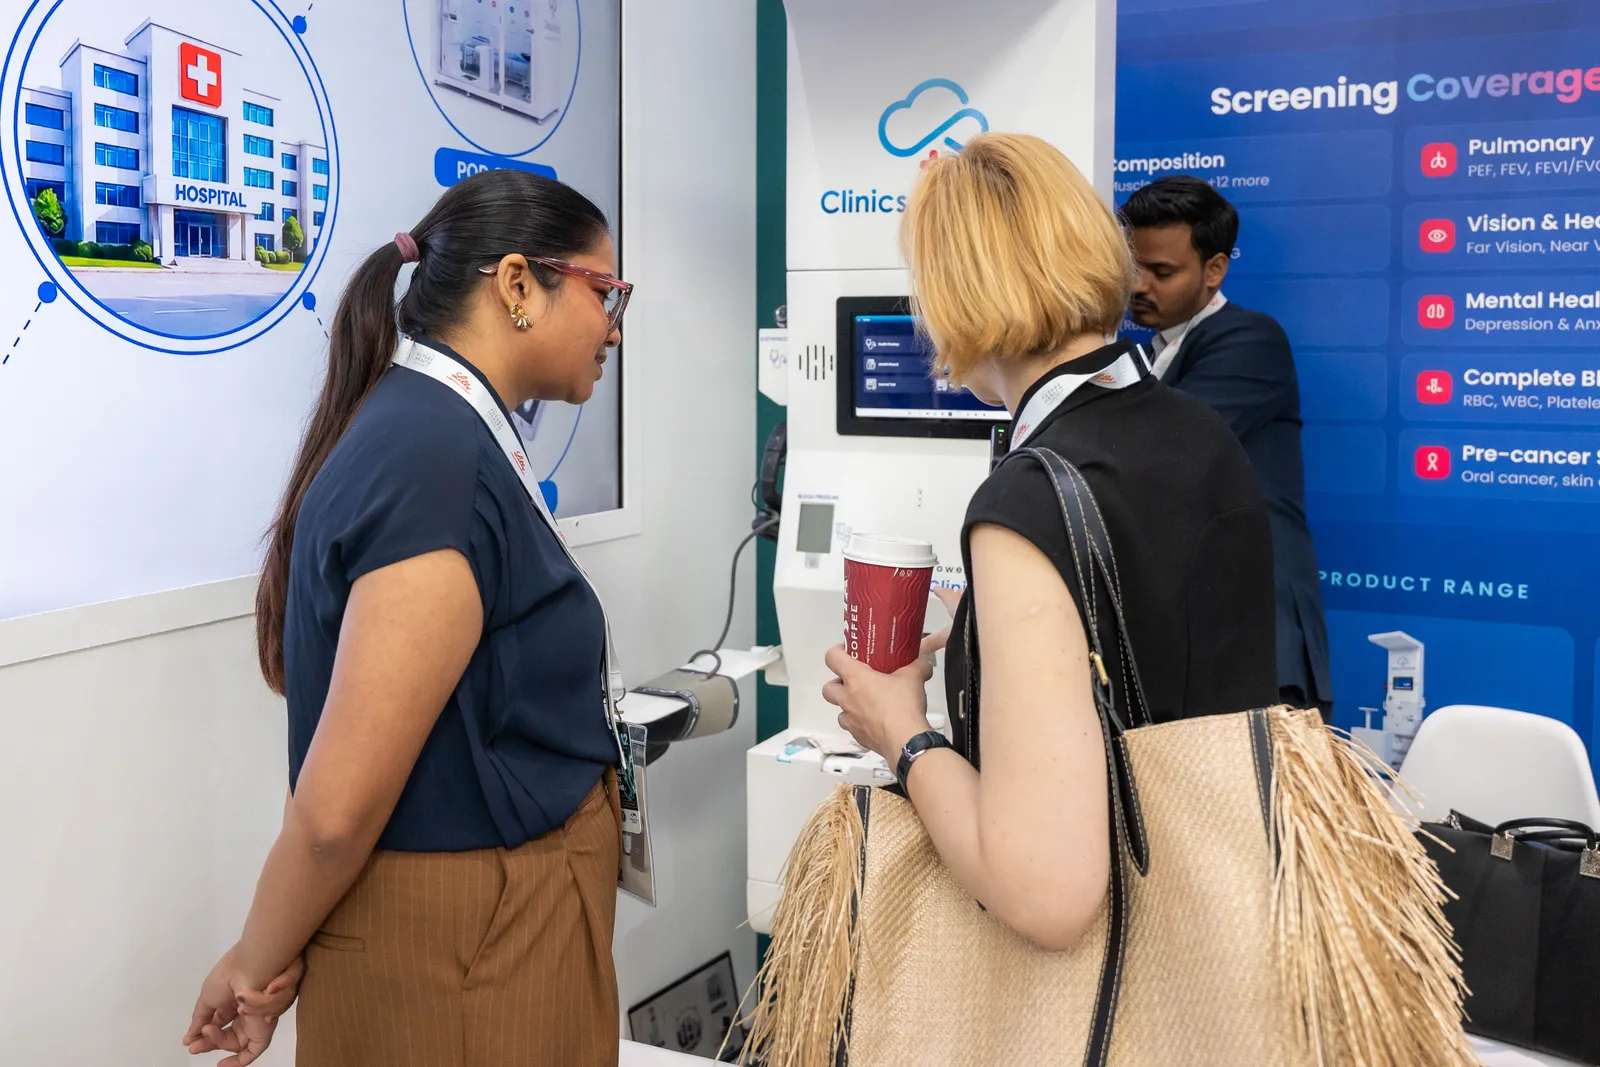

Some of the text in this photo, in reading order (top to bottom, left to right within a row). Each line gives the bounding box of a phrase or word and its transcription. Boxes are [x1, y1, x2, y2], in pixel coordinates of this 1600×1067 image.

[1210, 67, 1600, 115] Screening Coverage
[1469, 136, 1594, 155] Pulmonary
[1468, 164, 1496, 178] PEF,
[1500, 162, 1532, 177] FEV,
[1232, 176, 1270, 188] more
[175, 183, 247, 208] HOSPITAL
[820, 188, 907, 214] Clinics
[1467, 213, 1536, 232] Vision
[1541, 213, 1559, 230] &
[1466, 241, 1491, 254] Far
[1495, 239, 1546, 254] Vision,
[1550, 239, 1590, 252] Near
[1465, 291, 1543, 309] Mental
[1465, 317, 1553, 334] Depression
[1557, 318, 1570, 331] &
[1463, 368, 1576, 391] Complete
[1463, 394, 1498, 409] RBC,
[1501, 395, 1543, 410] WBC,
[1462, 445, 1591, 465] Pre-cancer
[1461, 470, 1494, 483] Oral
[1497, 473, 1559, 488] cancer,
[1562, 474, 1594, 487] skin
[1319, 570, 1529, 599] PRODUCT RANGE
[850, 604, 858, 660] COFFEE
